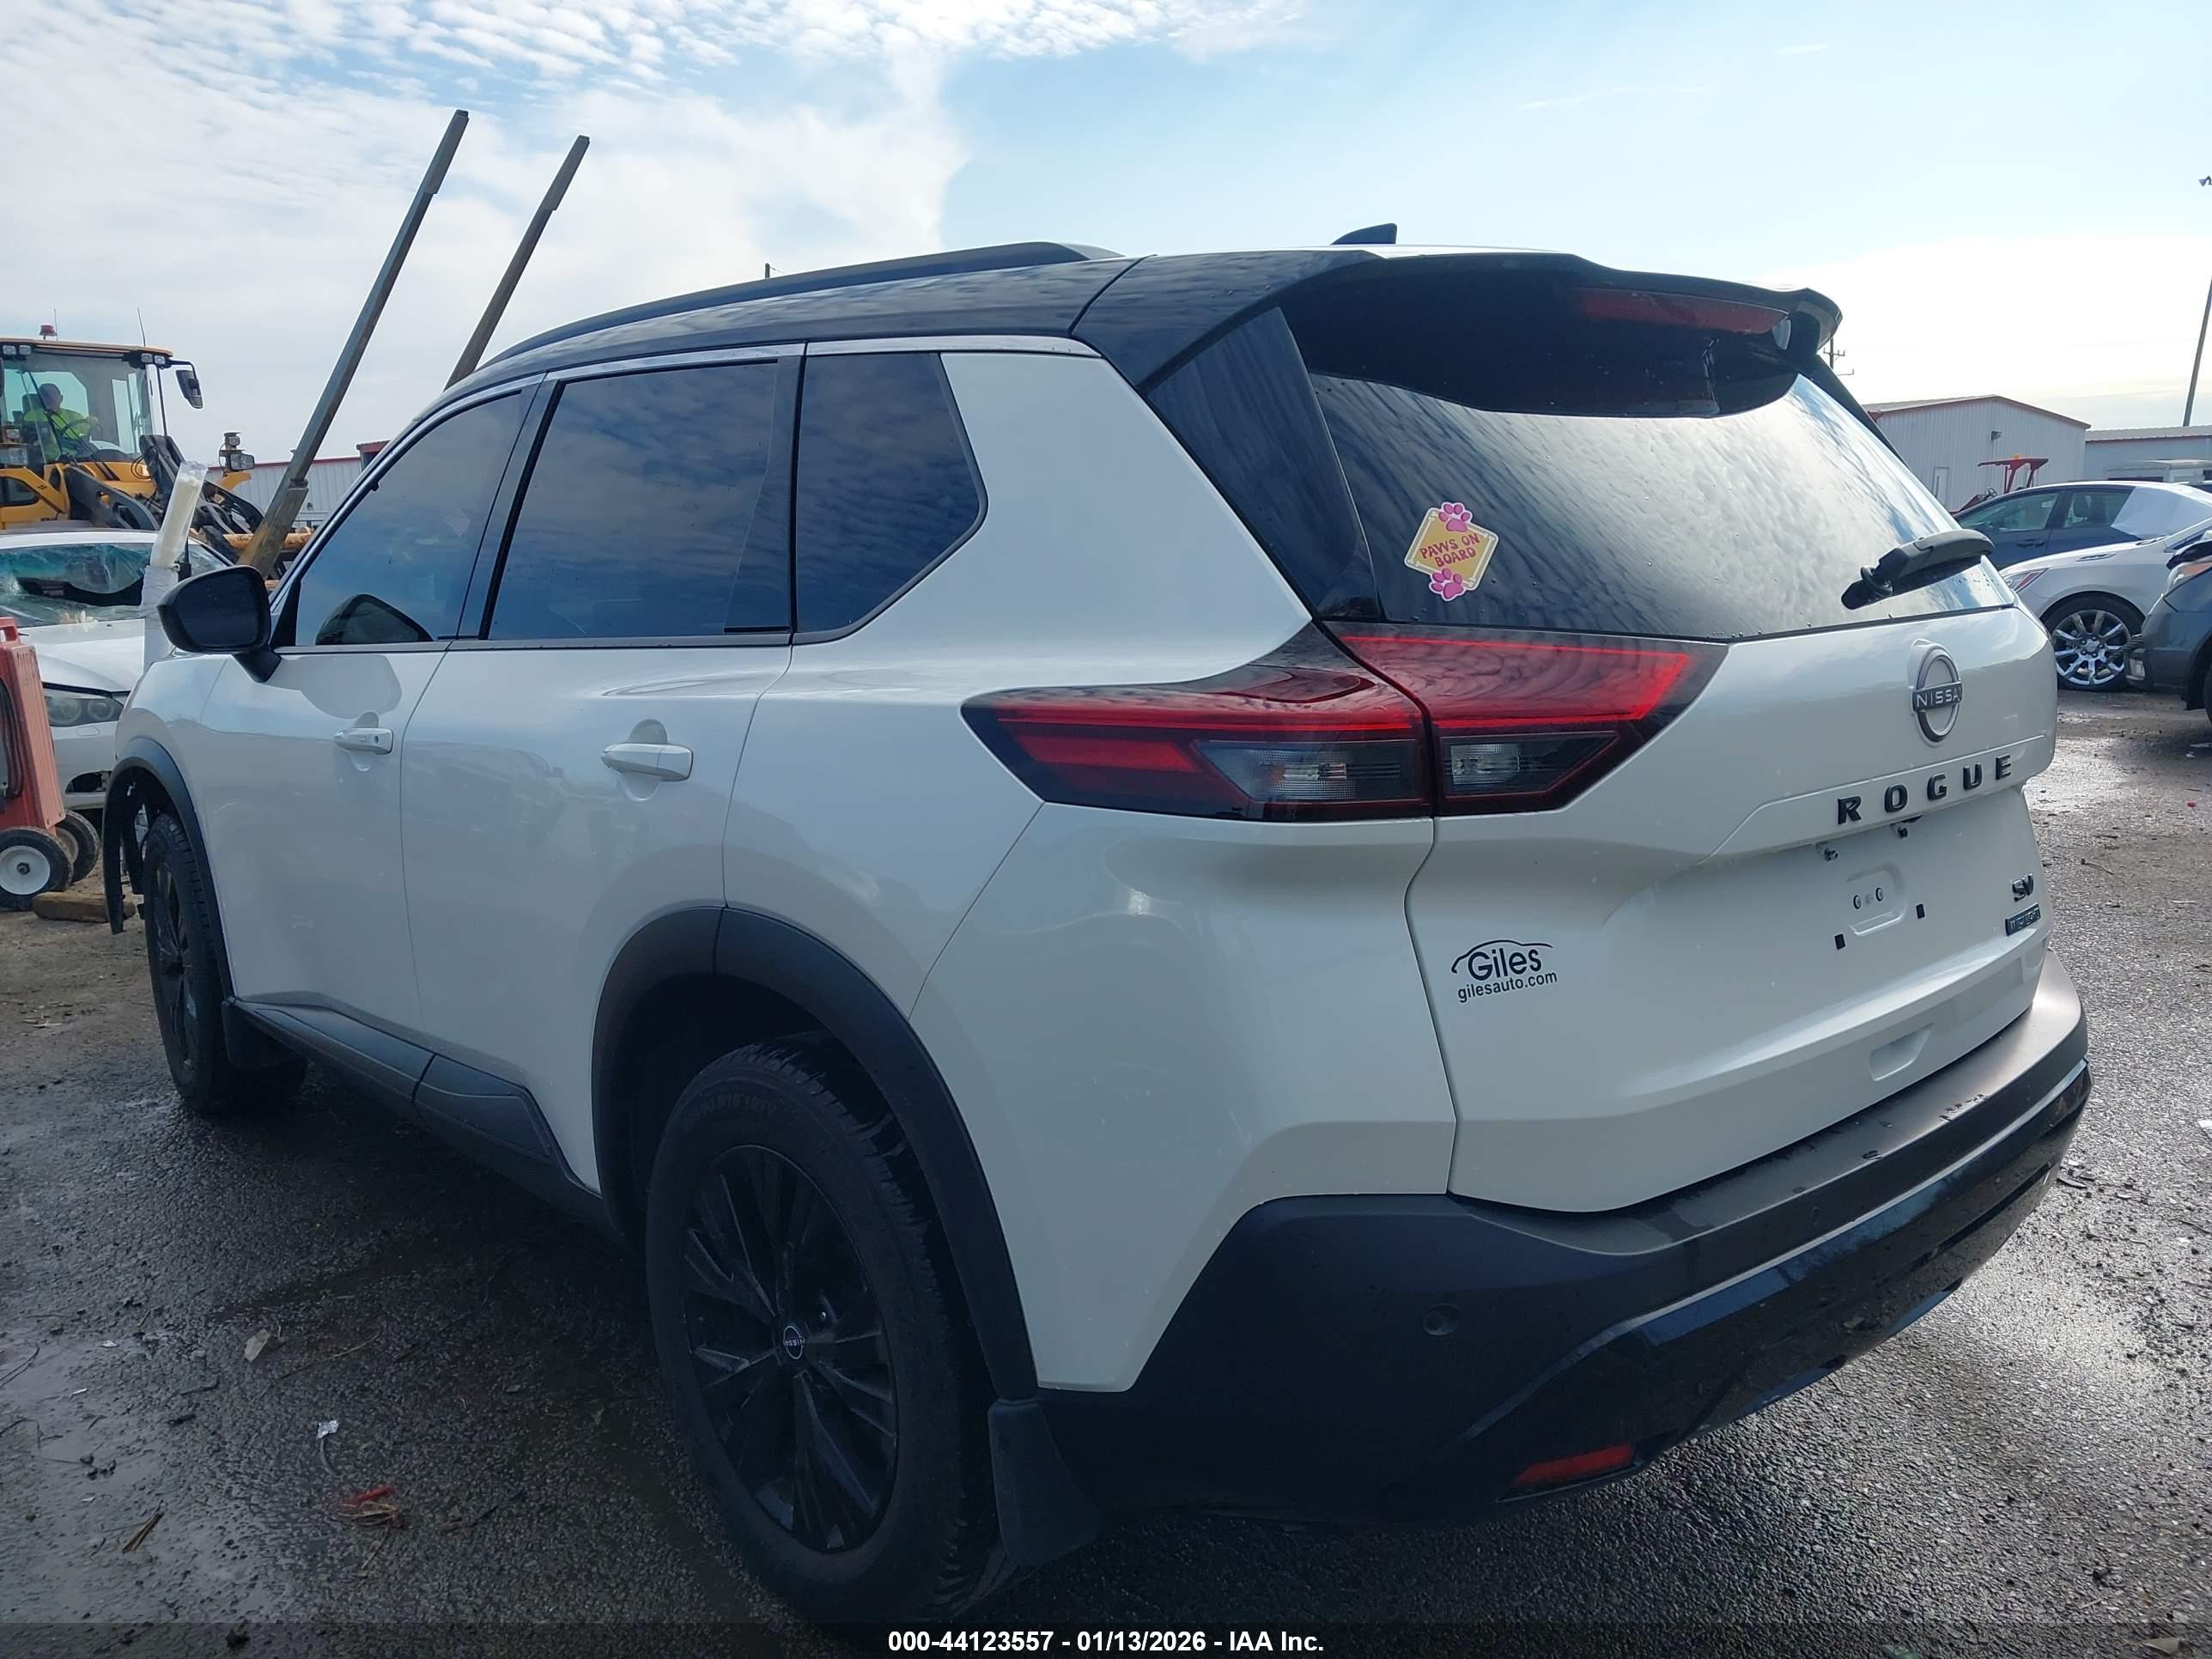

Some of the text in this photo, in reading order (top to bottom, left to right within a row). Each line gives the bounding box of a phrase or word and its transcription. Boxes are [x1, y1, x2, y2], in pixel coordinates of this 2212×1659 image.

[1419, 532, 1480, 559] PAWS ON
[1434, 547, 1477, 568] BOARD
[1837, 752, 2013, 825] ROGUE
[1468, 947, 1542, 981] Giles
[1457, 971, 1558, 1004] gilesauto.com
